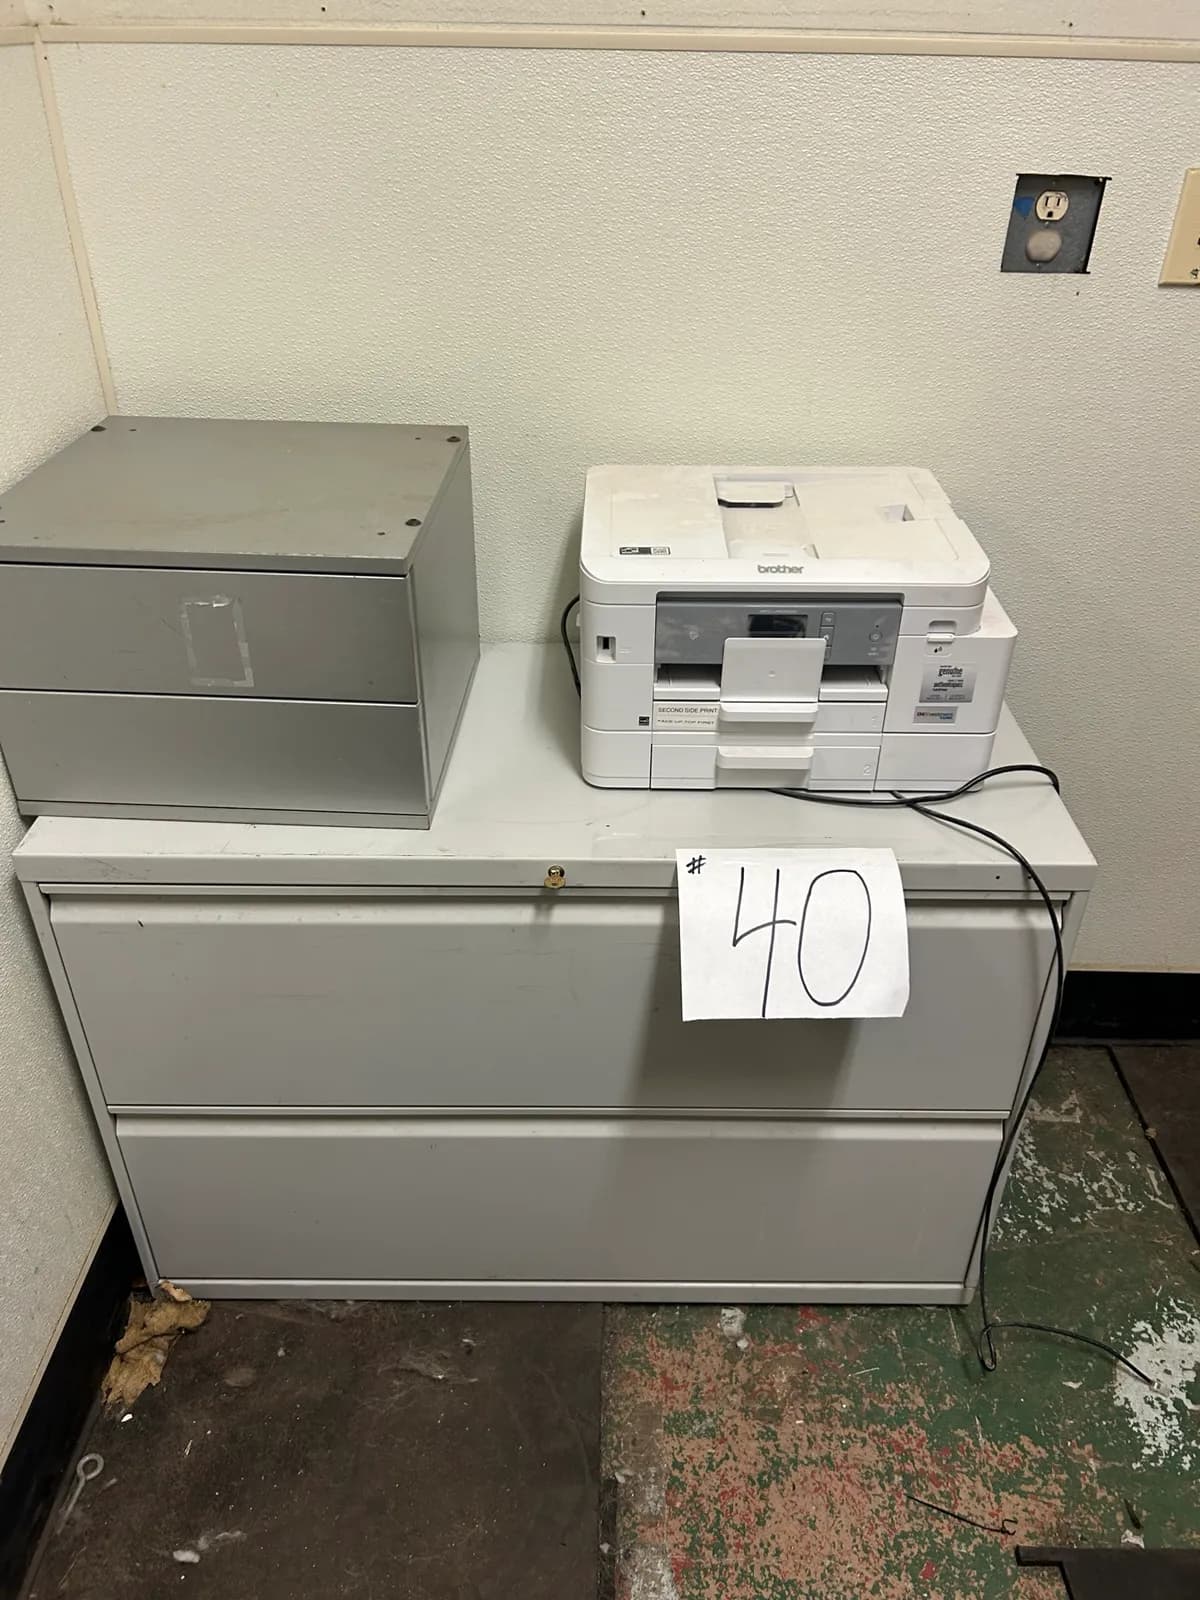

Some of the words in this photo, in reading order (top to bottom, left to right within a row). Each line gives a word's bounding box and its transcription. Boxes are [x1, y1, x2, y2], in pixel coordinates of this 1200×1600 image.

[757, 564, 804, 574] brother
[686, 855, 707, 875] #
[732, 867, 872, 1018] 40
